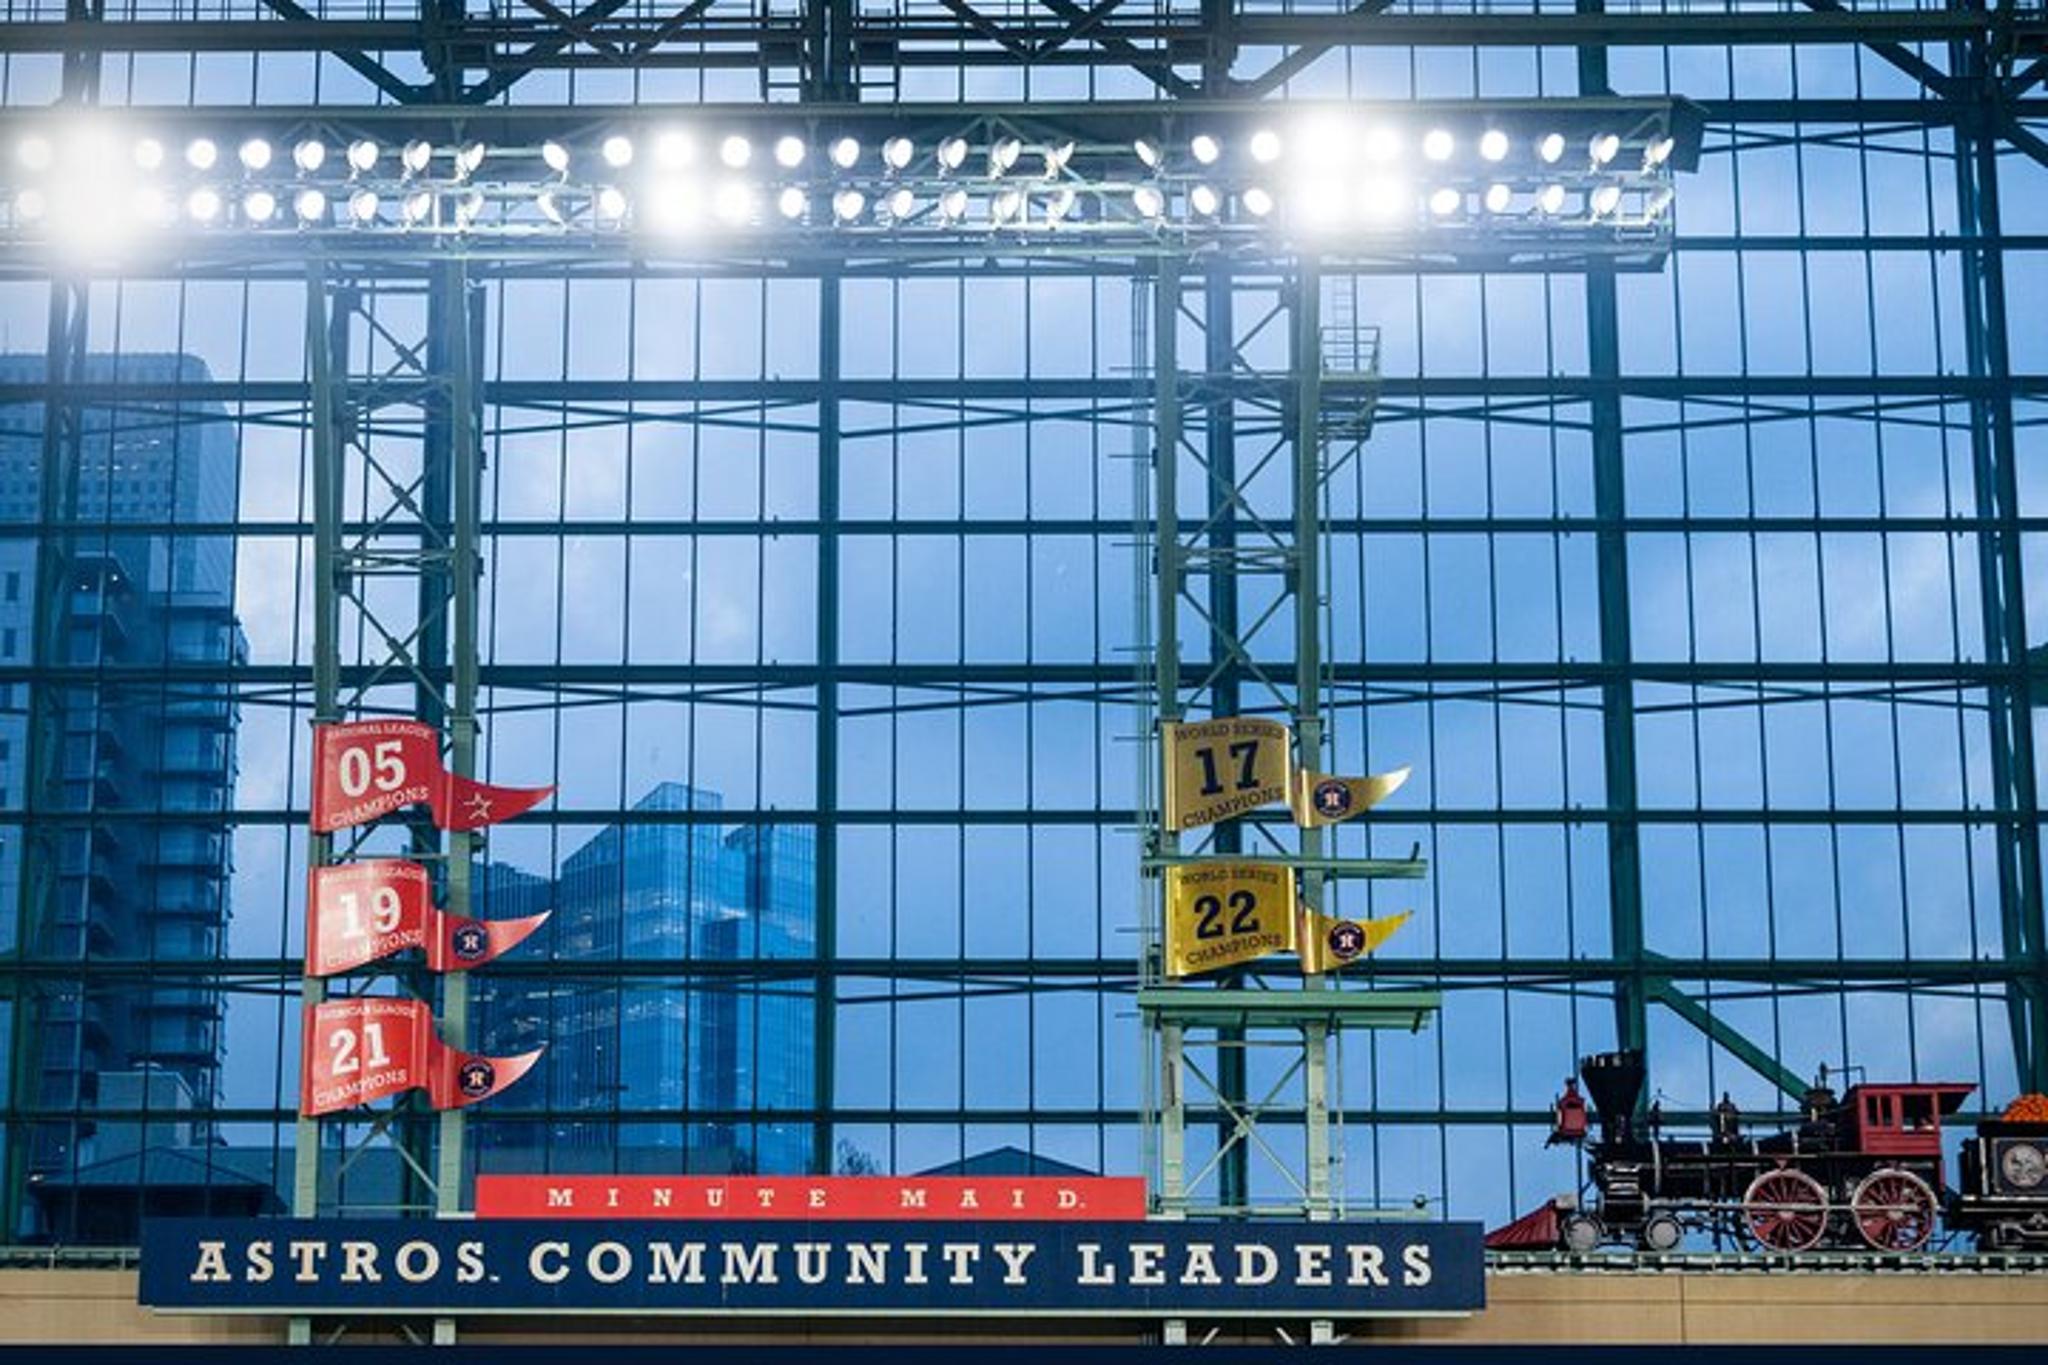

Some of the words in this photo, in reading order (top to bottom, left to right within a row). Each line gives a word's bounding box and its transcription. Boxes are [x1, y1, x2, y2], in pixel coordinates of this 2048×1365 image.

[384, 721, 430, 740] LEAGUE
[1175, 725, 1228, 742] WORLD
[1232, 724, 1284, 740] SERIES
[338, 739, 406, 798] 05
[1195, 740, 1260, 796] 17
[328, 786, 429, 827] CHAMPIONS
[1183, 787, 1285, 828] CHAMPIONS
[1181, 869, 1229, 885] WORLD
[338, 886, 401, 939] 19
[1194, 890, 1260, 939] 22
[1186, 933, 1283, 966] CHAMPIONS
[329, 1023, 391, 1076] 21
[315, 1069, 408, 1108] CHAMPIONS
[548, 1188, 826, 1207] MINUTE
[528, 1241, 1036, 1285] COMMUNITY
[1077, 1243, 1433, 1287] LEADERS
